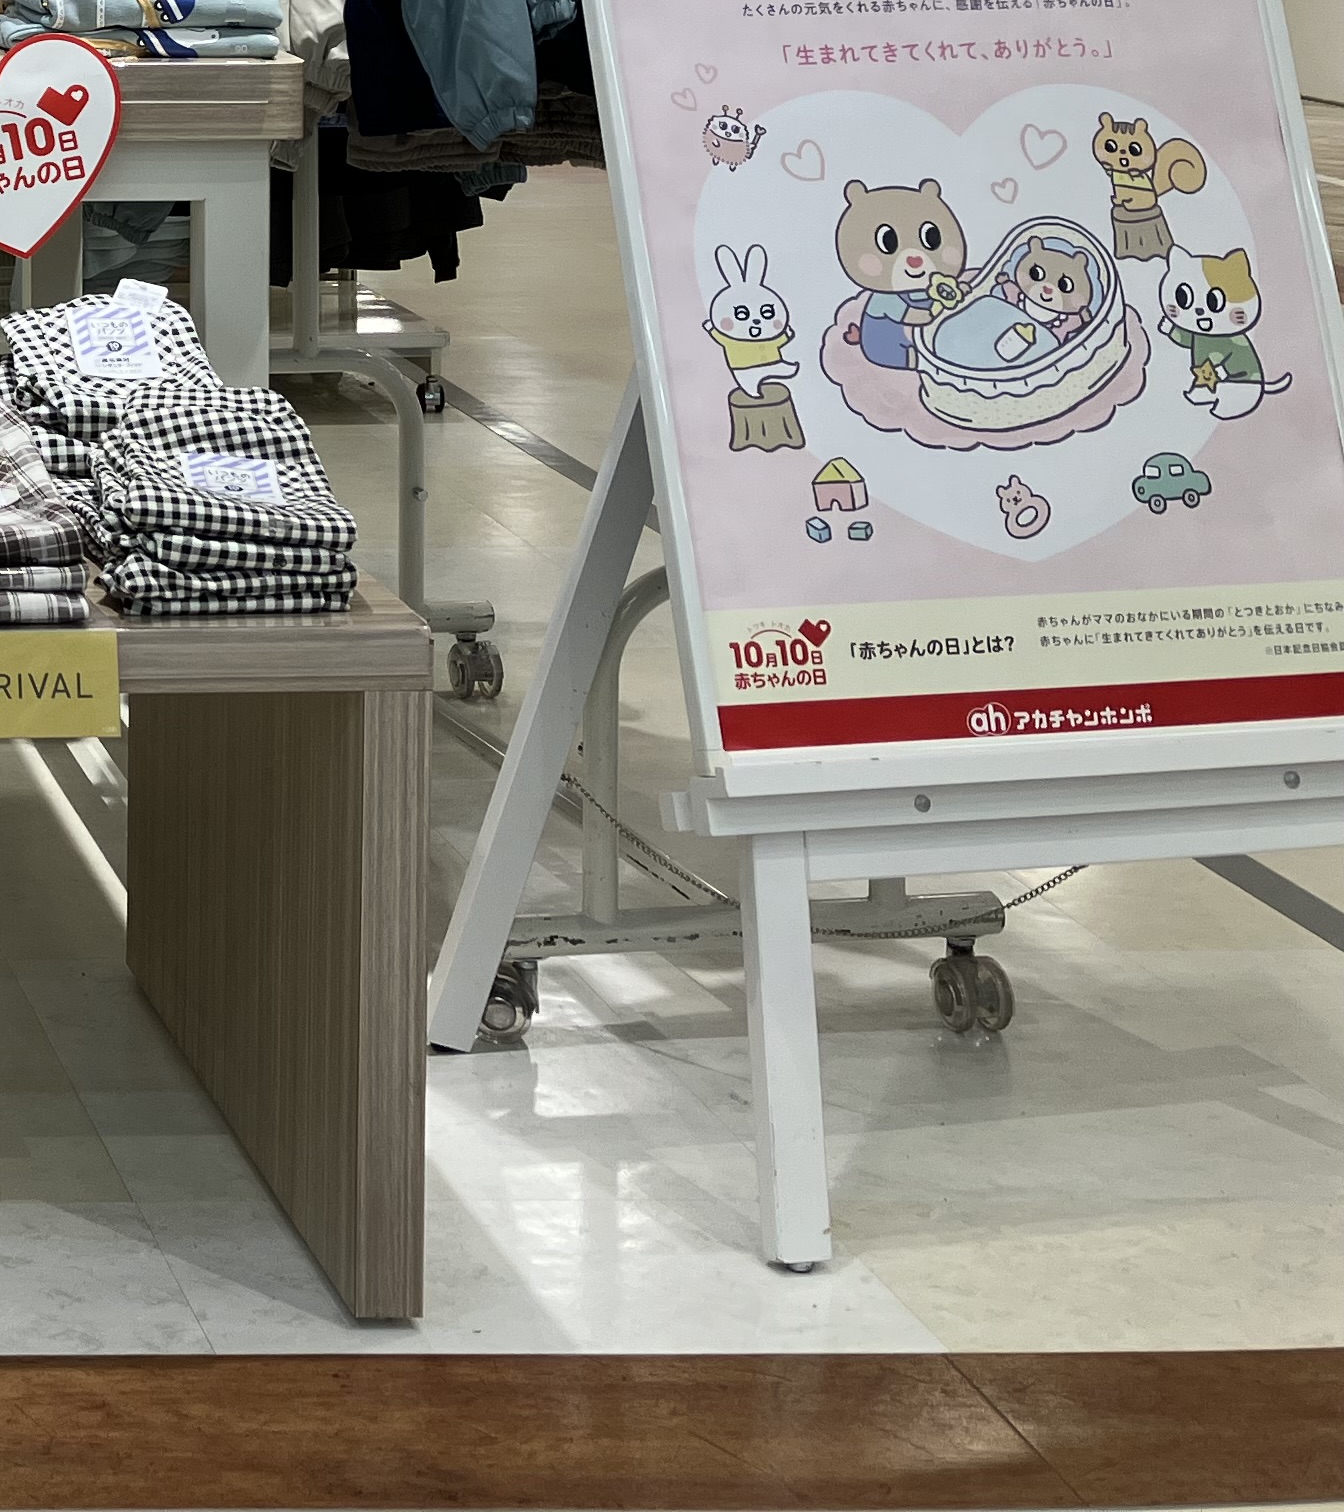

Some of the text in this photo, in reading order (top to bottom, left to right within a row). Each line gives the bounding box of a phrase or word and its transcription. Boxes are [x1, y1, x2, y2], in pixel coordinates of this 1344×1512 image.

[782, 37, 1112, 65] 「生まれてきてくれて、ありがとう。」
[91, 321, 128, 330] いつもの
[729, 638, 823, 669] 10月10日
[734, 668, 827, 690] 赤ちゃんの日
[1014, 703, 1153, 730] アカチャンホンポ
